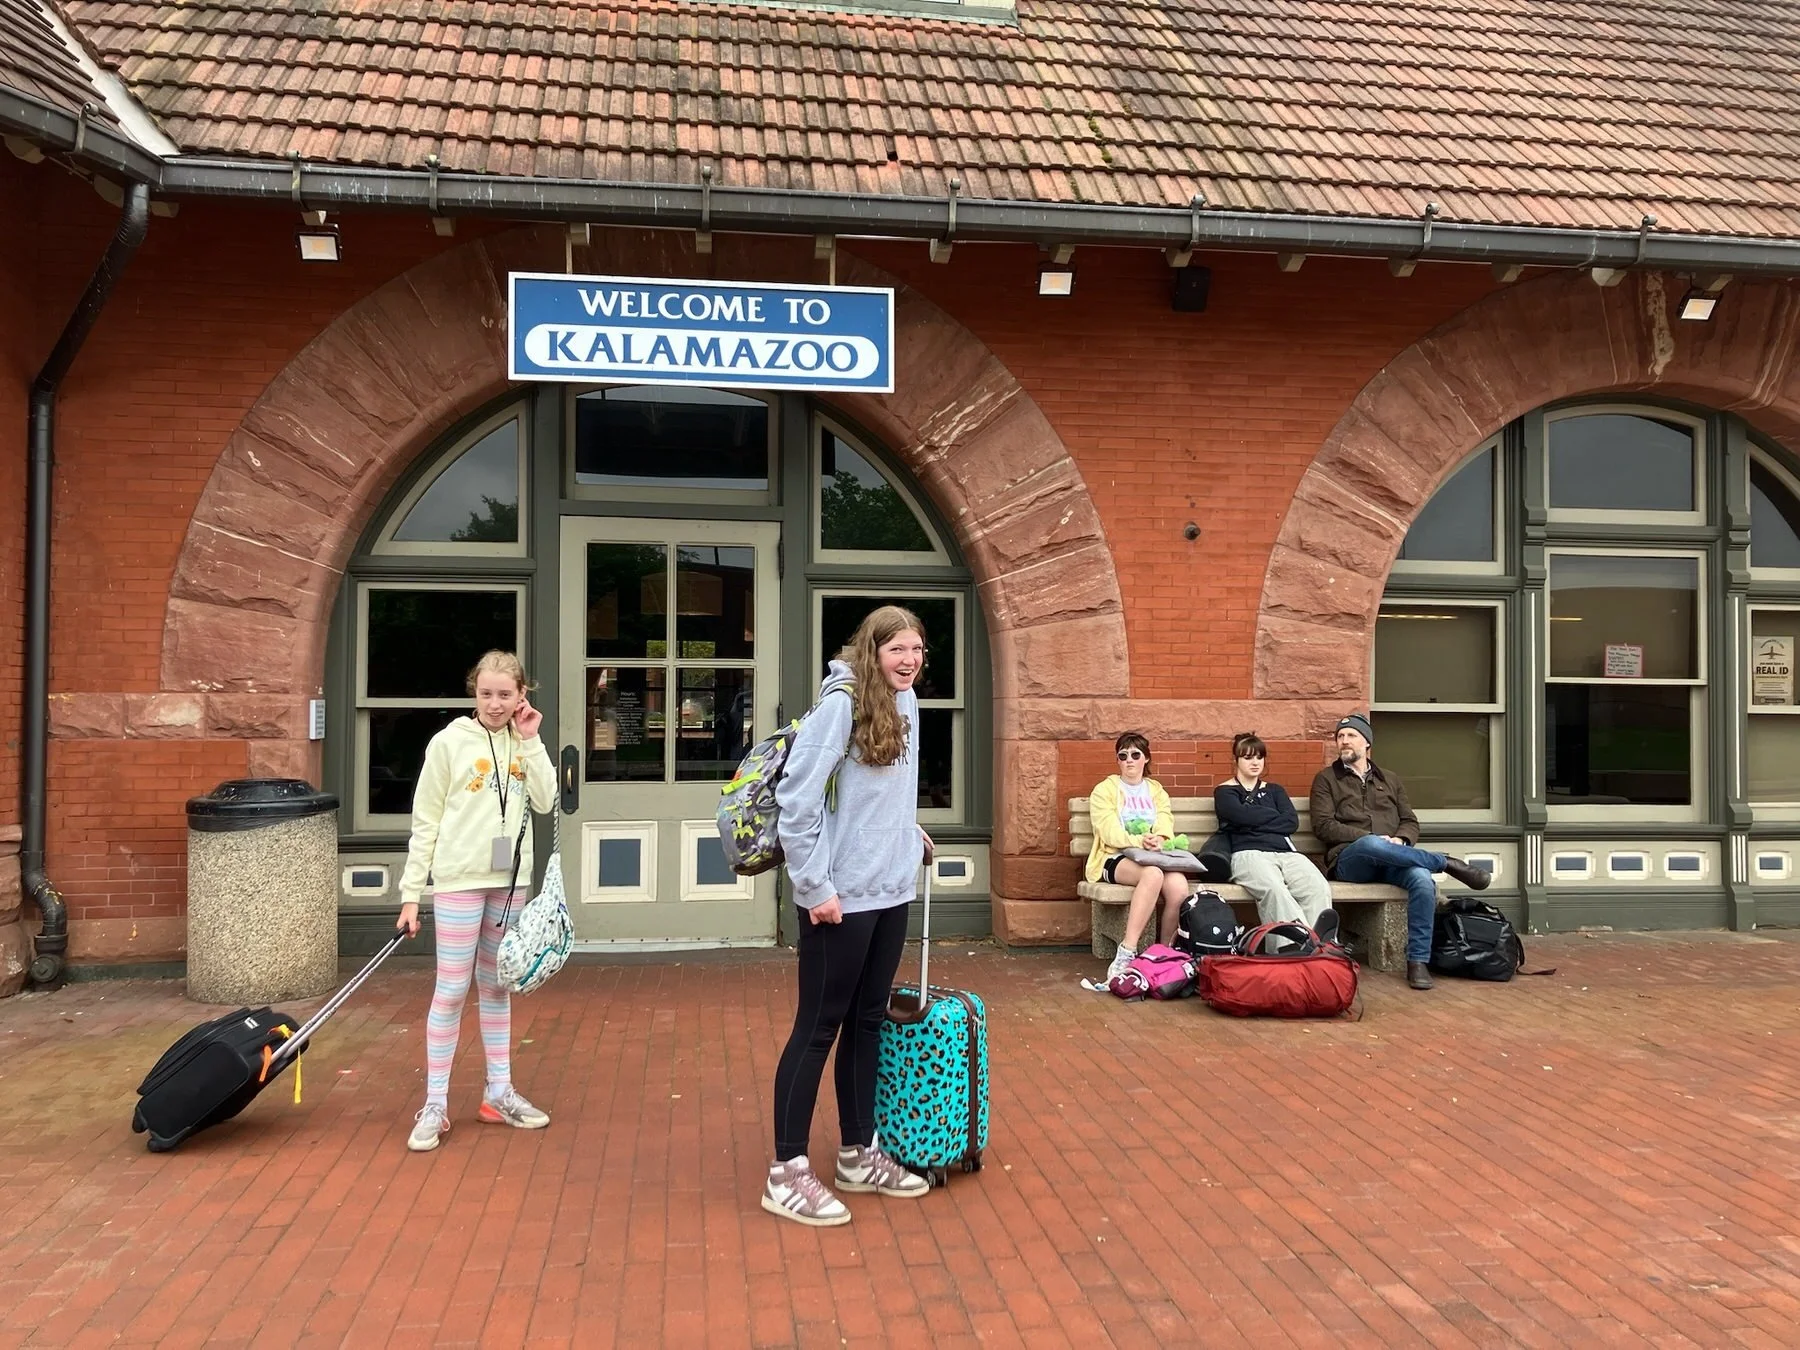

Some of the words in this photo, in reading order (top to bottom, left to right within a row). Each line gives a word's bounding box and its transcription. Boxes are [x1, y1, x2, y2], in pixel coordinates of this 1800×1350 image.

[577, 288, 766, 323] WELCOME
[783, 297, 832, 325] TO
[547, 330, 859, 372] KALAMAZOO
[1756, 666, 1777, 675] REAL
[1779, 666, 1789, 675] ID
